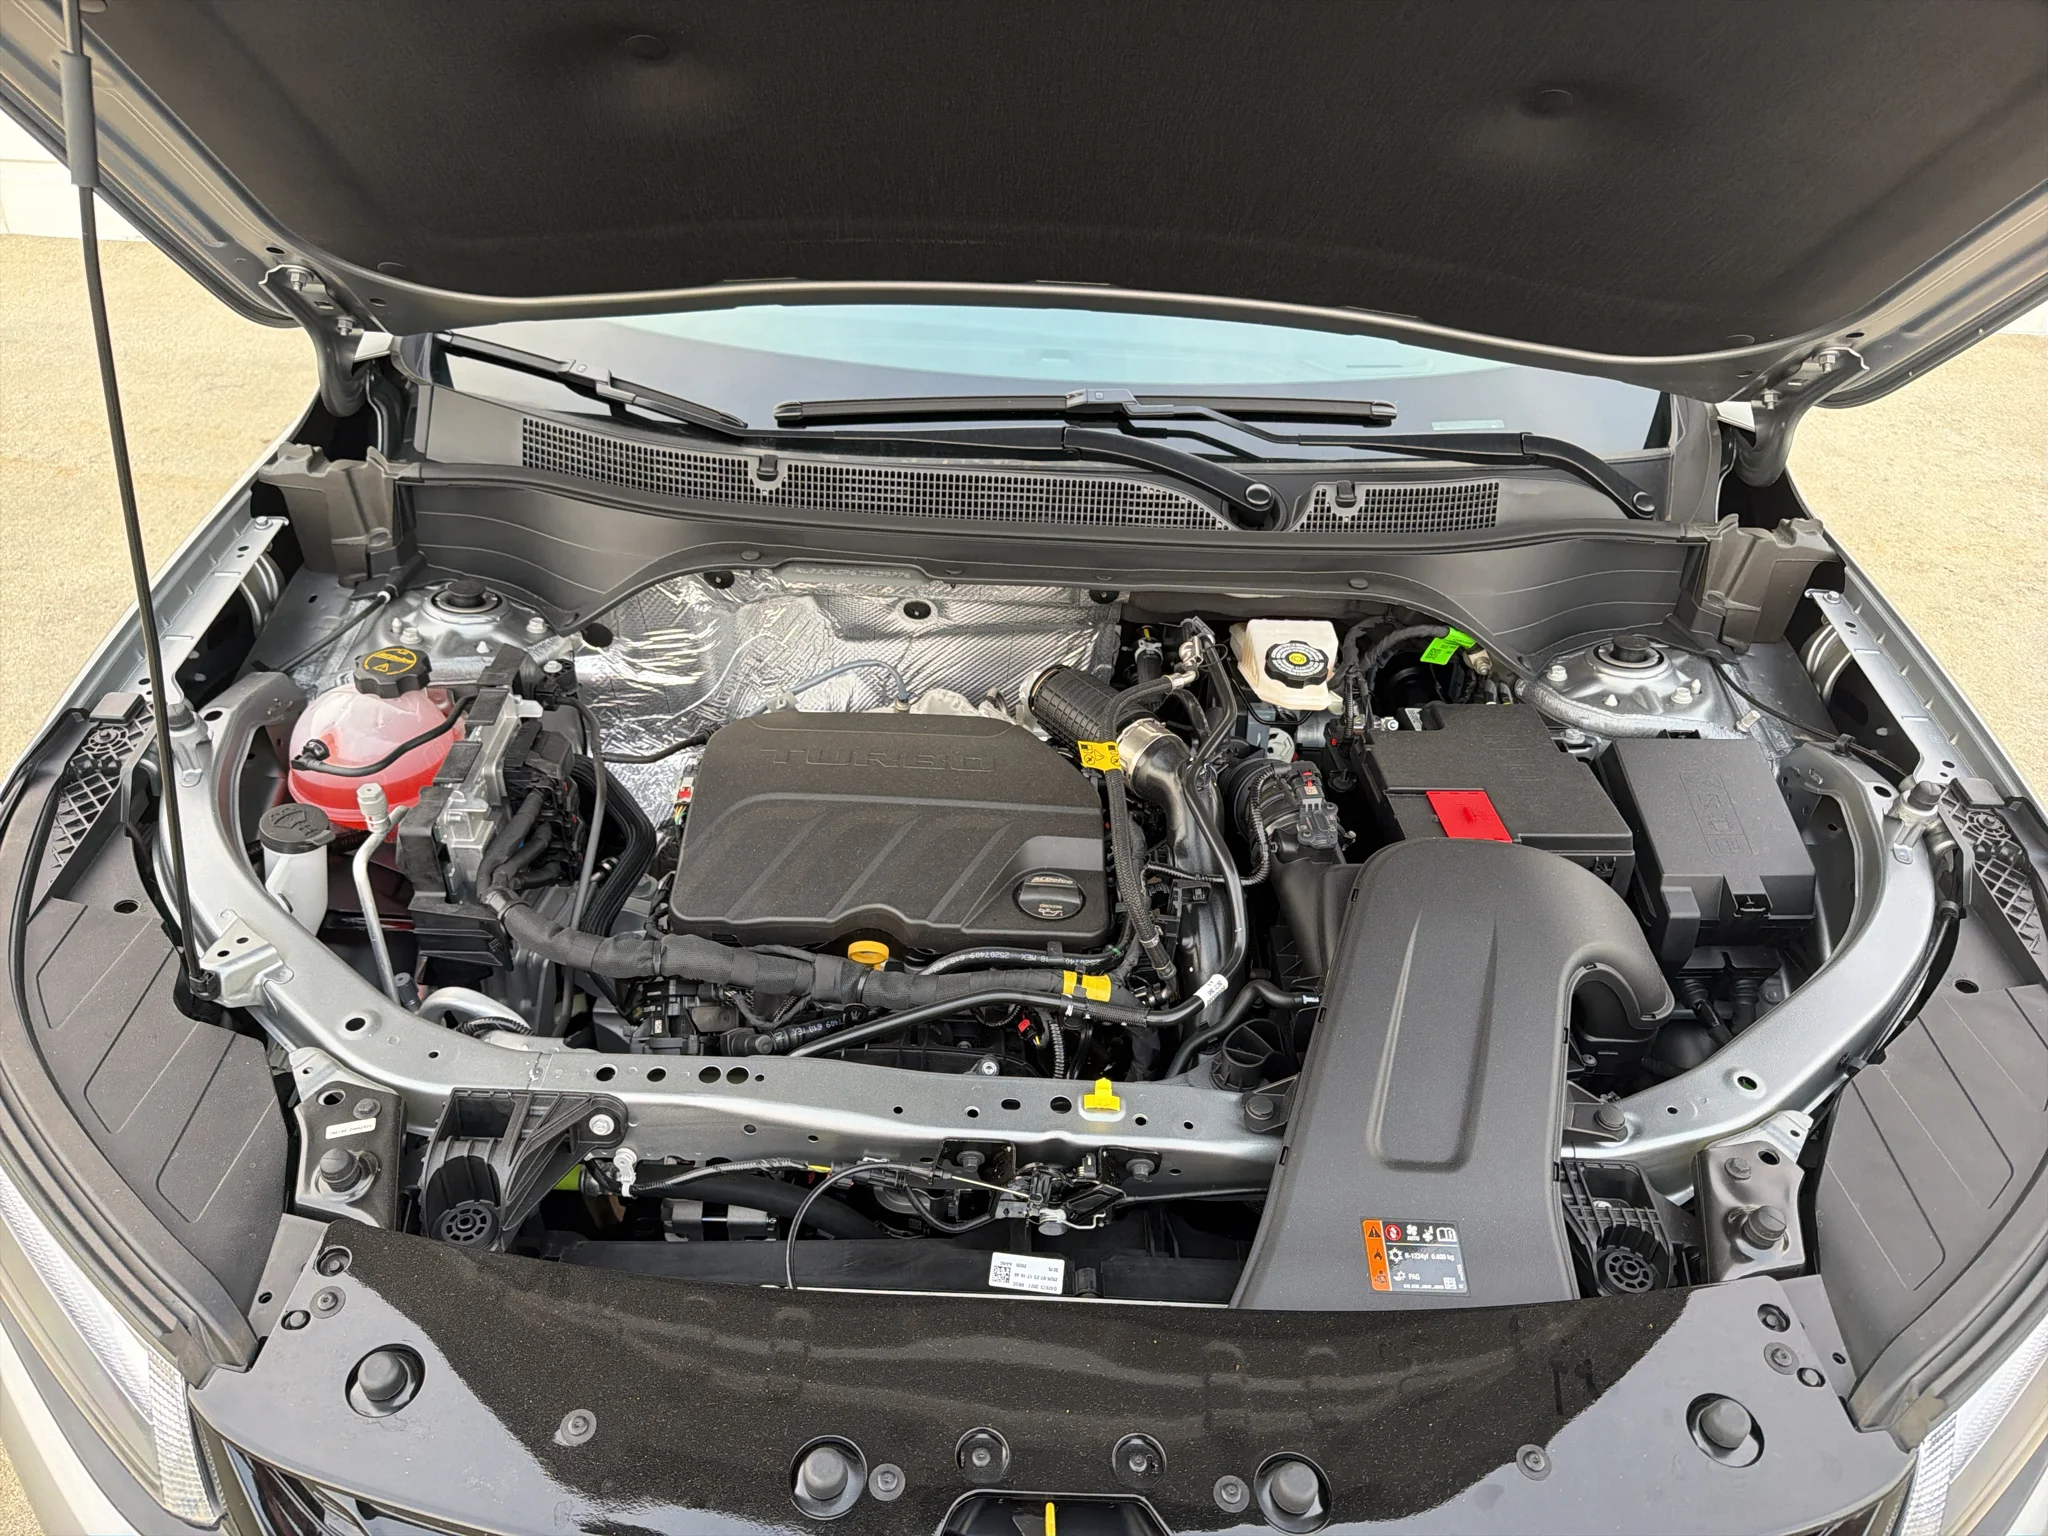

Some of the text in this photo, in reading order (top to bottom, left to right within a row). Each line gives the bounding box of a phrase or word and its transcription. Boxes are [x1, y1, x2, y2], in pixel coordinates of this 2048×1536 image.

[760, 749, 997, 773] TURBO
[1031, 876, 1074, 885] ACDelco
[969, 951, 1010, 959] 25207409
[1021, 953, 1037, 962] MEX
[1447, 1254, 1455, 1262] kg
[1408, 1273, 1420, 1281] PAG
